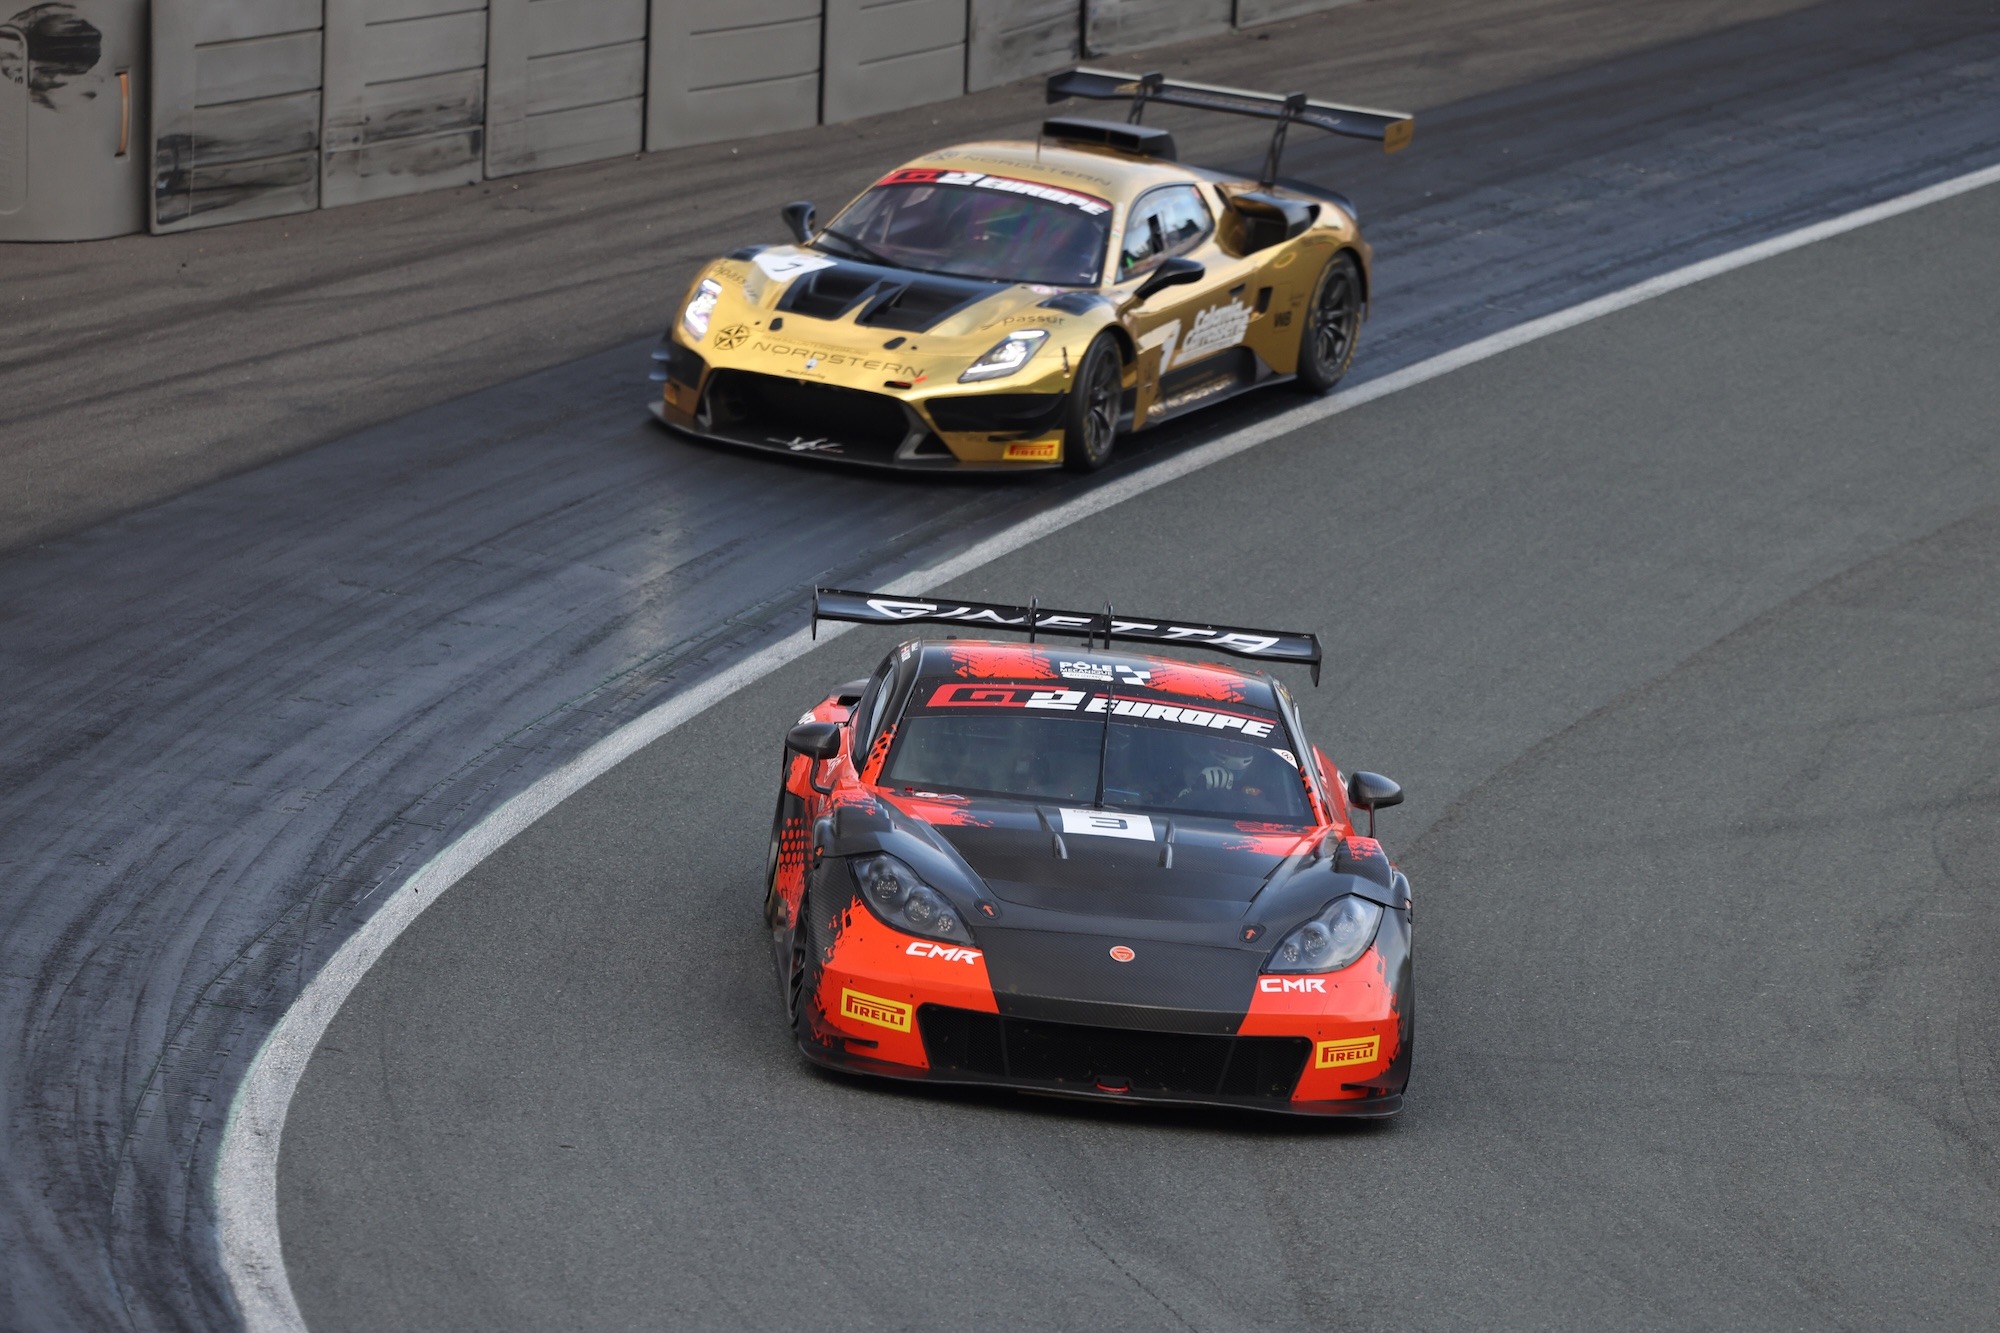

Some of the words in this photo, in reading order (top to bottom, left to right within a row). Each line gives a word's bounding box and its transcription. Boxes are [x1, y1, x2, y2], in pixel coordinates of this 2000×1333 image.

[964, 154, 1112, 187] NORDSTERN
[974, 177, 1110, 216] EUROPE
[1002, 315, 1065, 328] passur
[752, 341, 926, 378] NORDSTERN
[1008, 444, 1055, 456] PIRELLI
[866, 599, 1280, 653] GINETTA
[1059, 661, 1113, 672] PÔLE
[1084, 697, 1275, 738] EUROPE
[1088, 815, 1129, 830] 3
[905, 941, 983, 965] CMR
[1260, 977, 1327, 993] CMR
[846, 994, 906, 1026] PIRELLI
[1322, 1041, 1375, 1063] PIRELLI
